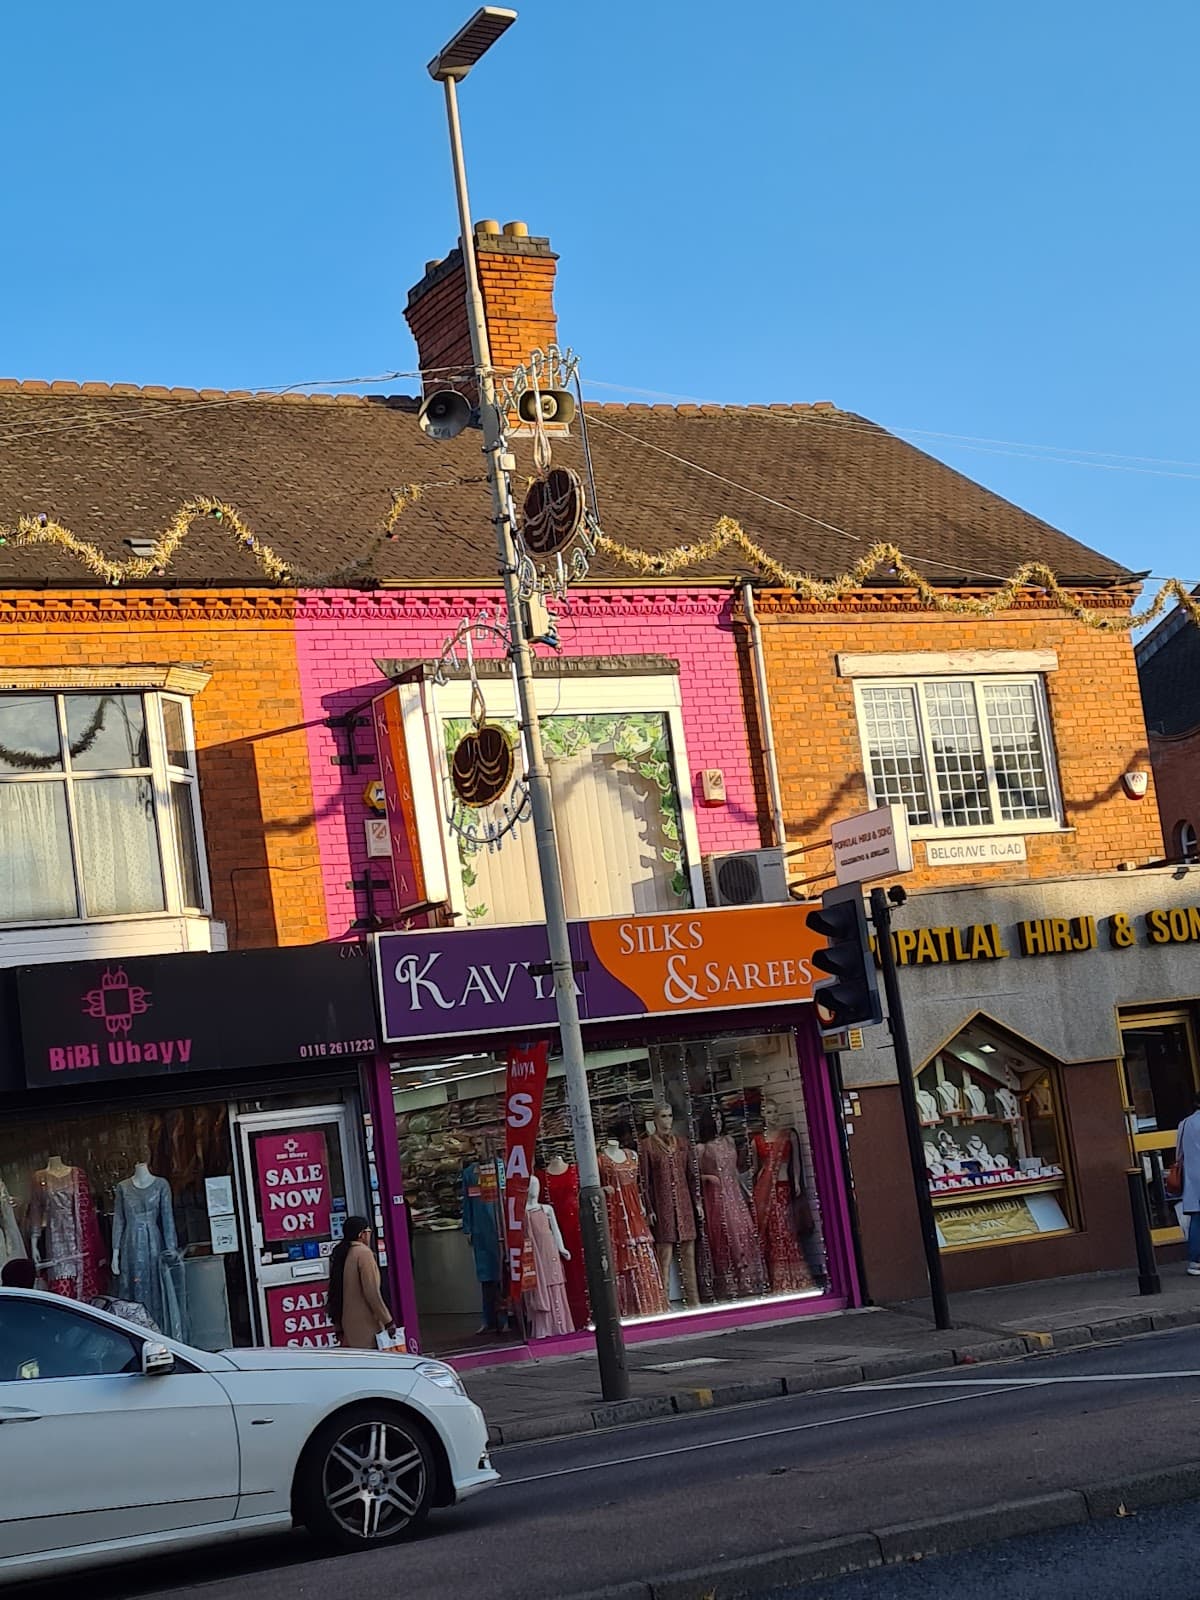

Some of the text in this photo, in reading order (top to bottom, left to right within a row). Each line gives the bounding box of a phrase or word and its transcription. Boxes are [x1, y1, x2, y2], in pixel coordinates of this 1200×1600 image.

[377, 713, 409, 894] KAVYA
[931, 842, 1022, 860] BELGRAVE ROAD
[619, 921, 704, 955] SILKS
[868, 923, 1010, 965] PATLAL
[1023, 915, 1098, 956] HIRJI
[1114, 912, 1137, 947] &
[664, 954, 813, 1004] & SAREES
[300, 1043, 327, 1058] 0116
[265, 1163, 324, 1187] SALE
[506, 1092, 533, 1282] SALE
[269, 1187, 323, 1210] NOW
[282, 1211, 316, 1232] ON
